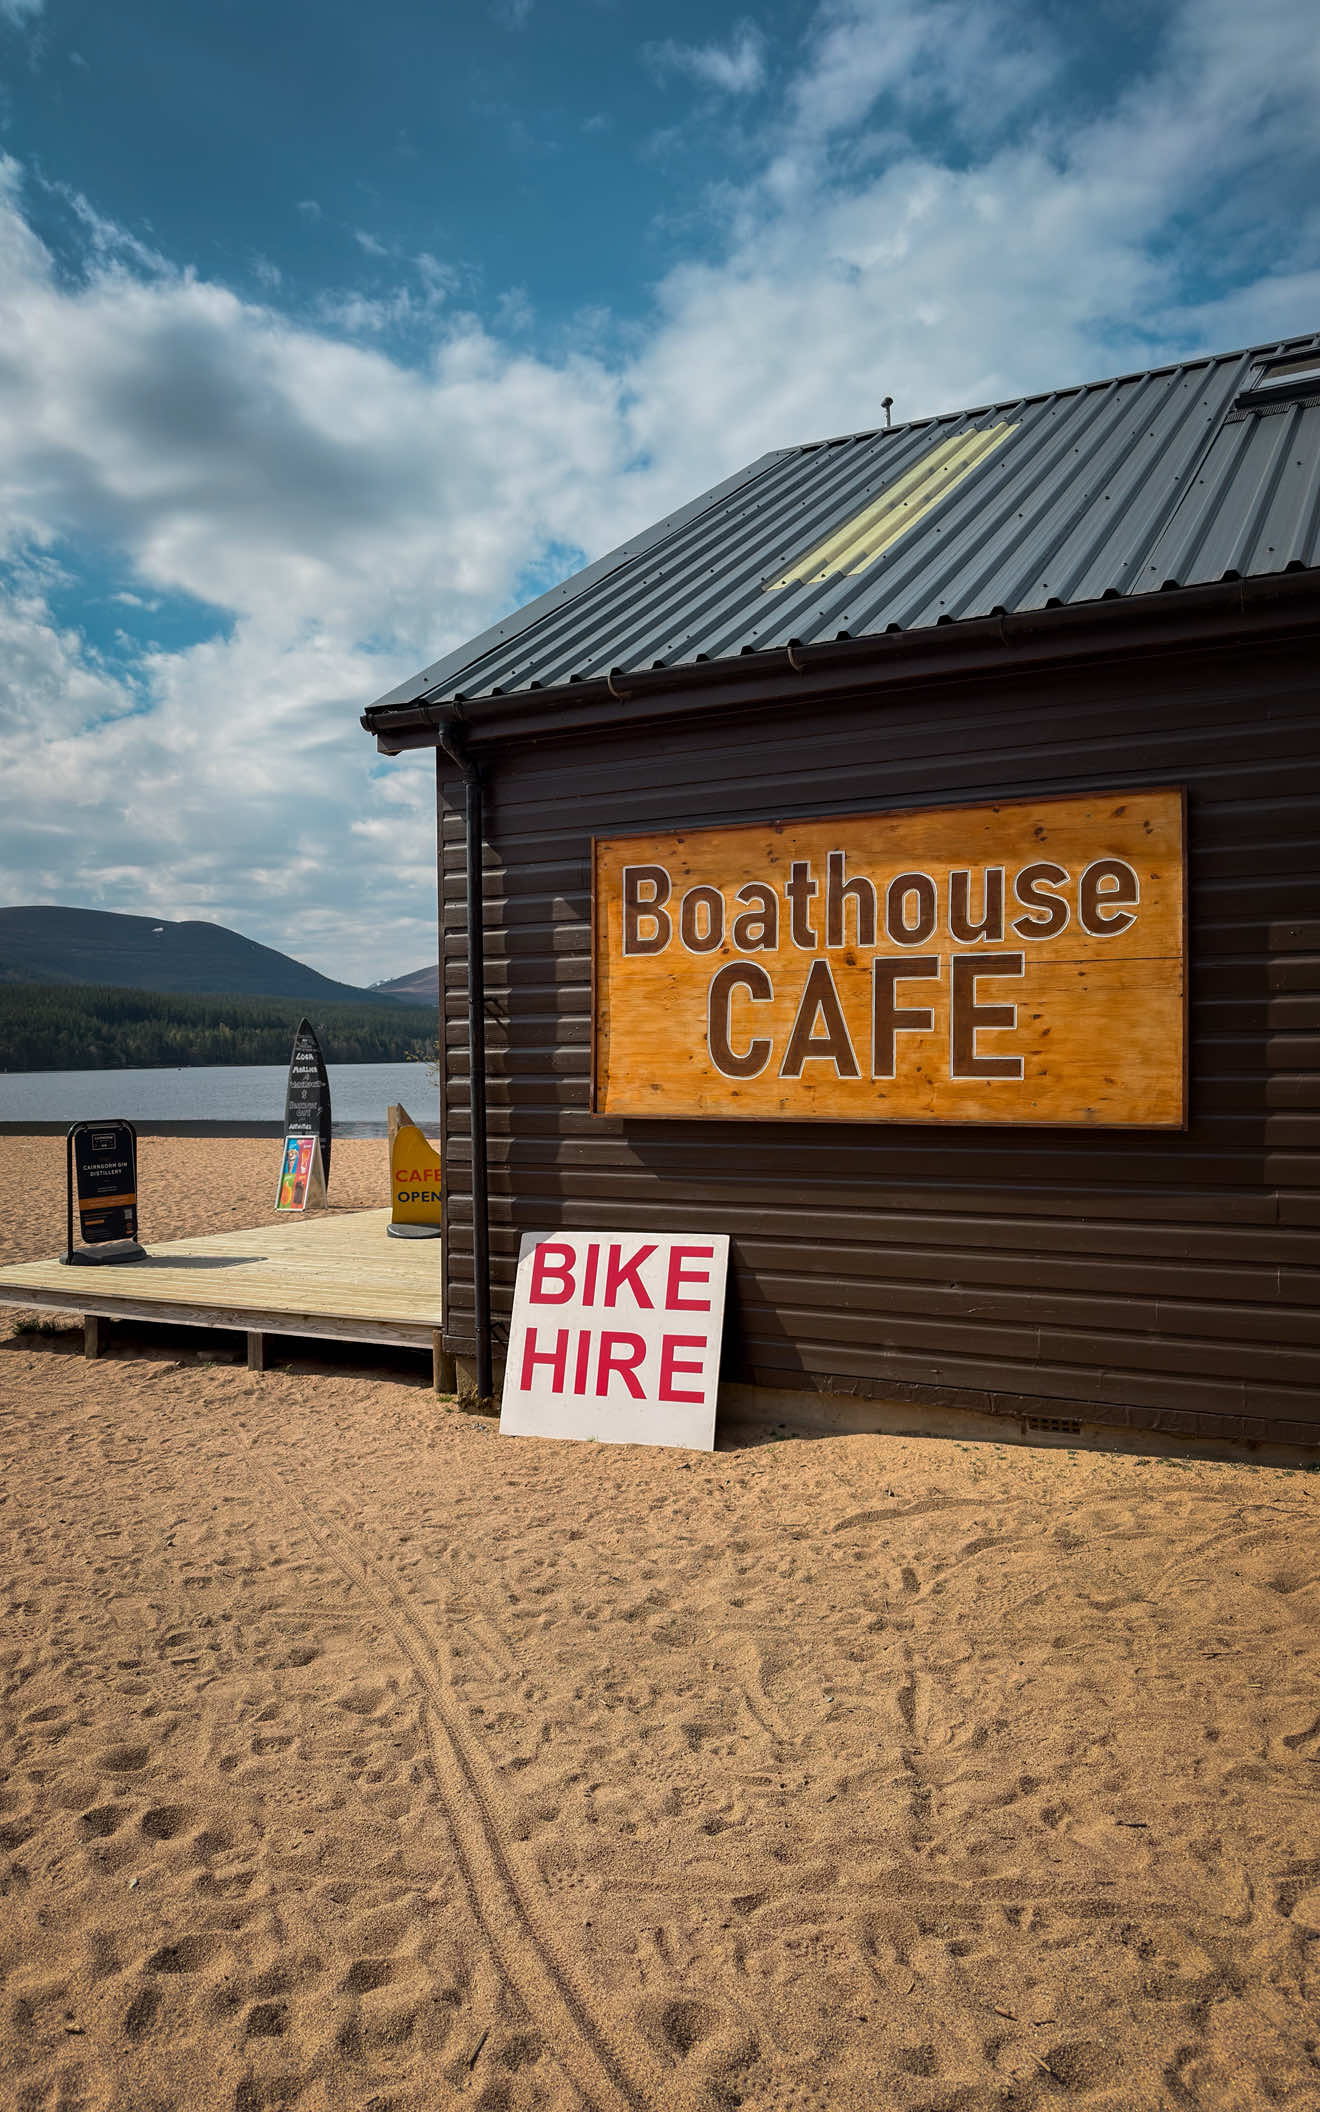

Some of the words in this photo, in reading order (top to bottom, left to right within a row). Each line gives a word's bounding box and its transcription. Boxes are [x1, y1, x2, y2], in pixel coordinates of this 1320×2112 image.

[622, 850, 1141, 957] Boathouse
[707, 951, 1025, 1081] CAFE
[395, 1168, 441, 1182] CAFE
[398, 1191, 441, 1202] OPEN
[529, 1242, 714, 1312] BIKE
[520, 1327, 708, 1404] HIRE
